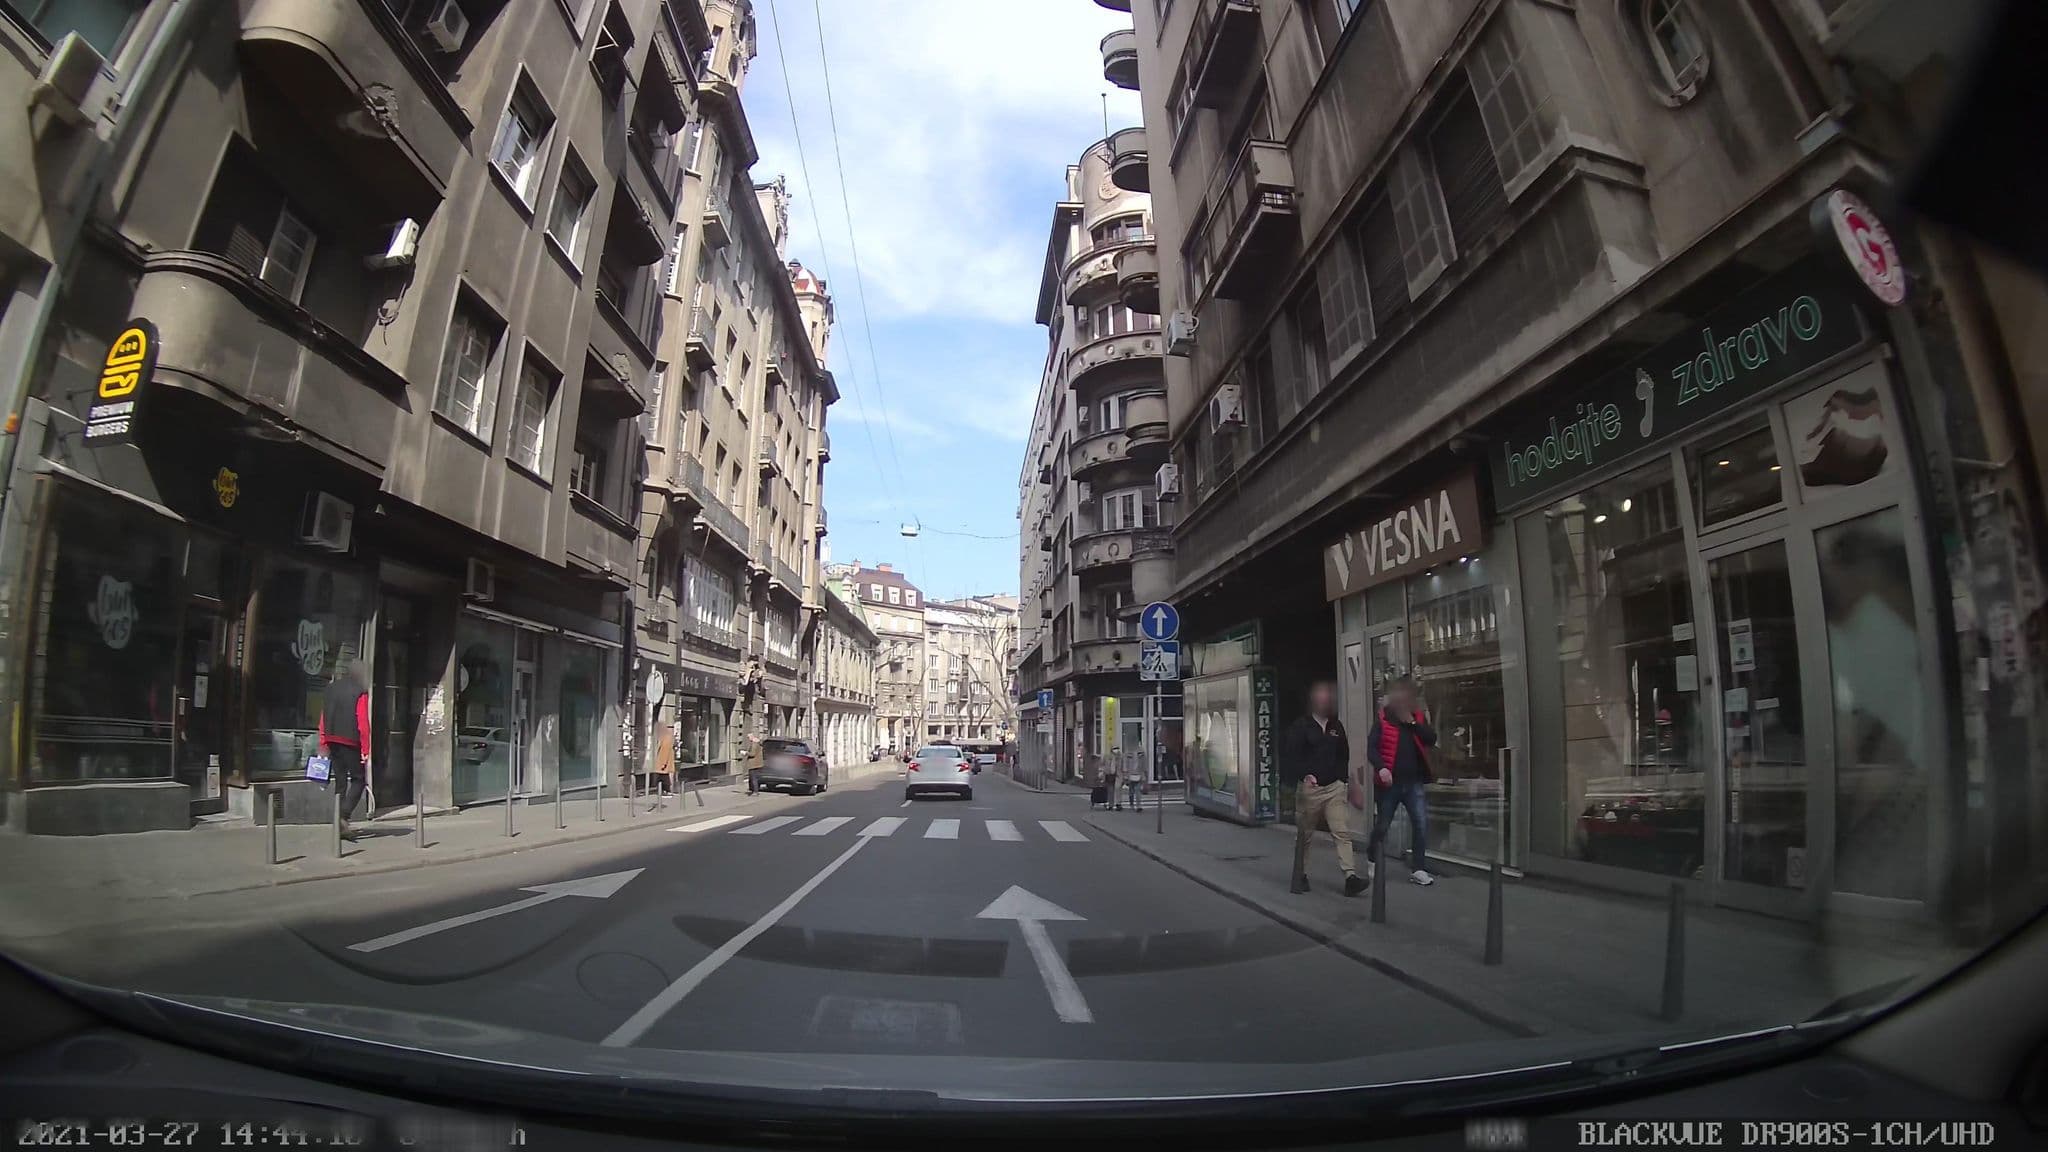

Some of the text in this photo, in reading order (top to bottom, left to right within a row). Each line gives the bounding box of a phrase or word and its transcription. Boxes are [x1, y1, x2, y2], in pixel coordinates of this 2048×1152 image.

[85, 420, 130, 437] BURGERS
[1503, 295, 1823, 487] hodajte zdravo
[1360, 490, 1462, 577] VESNA
